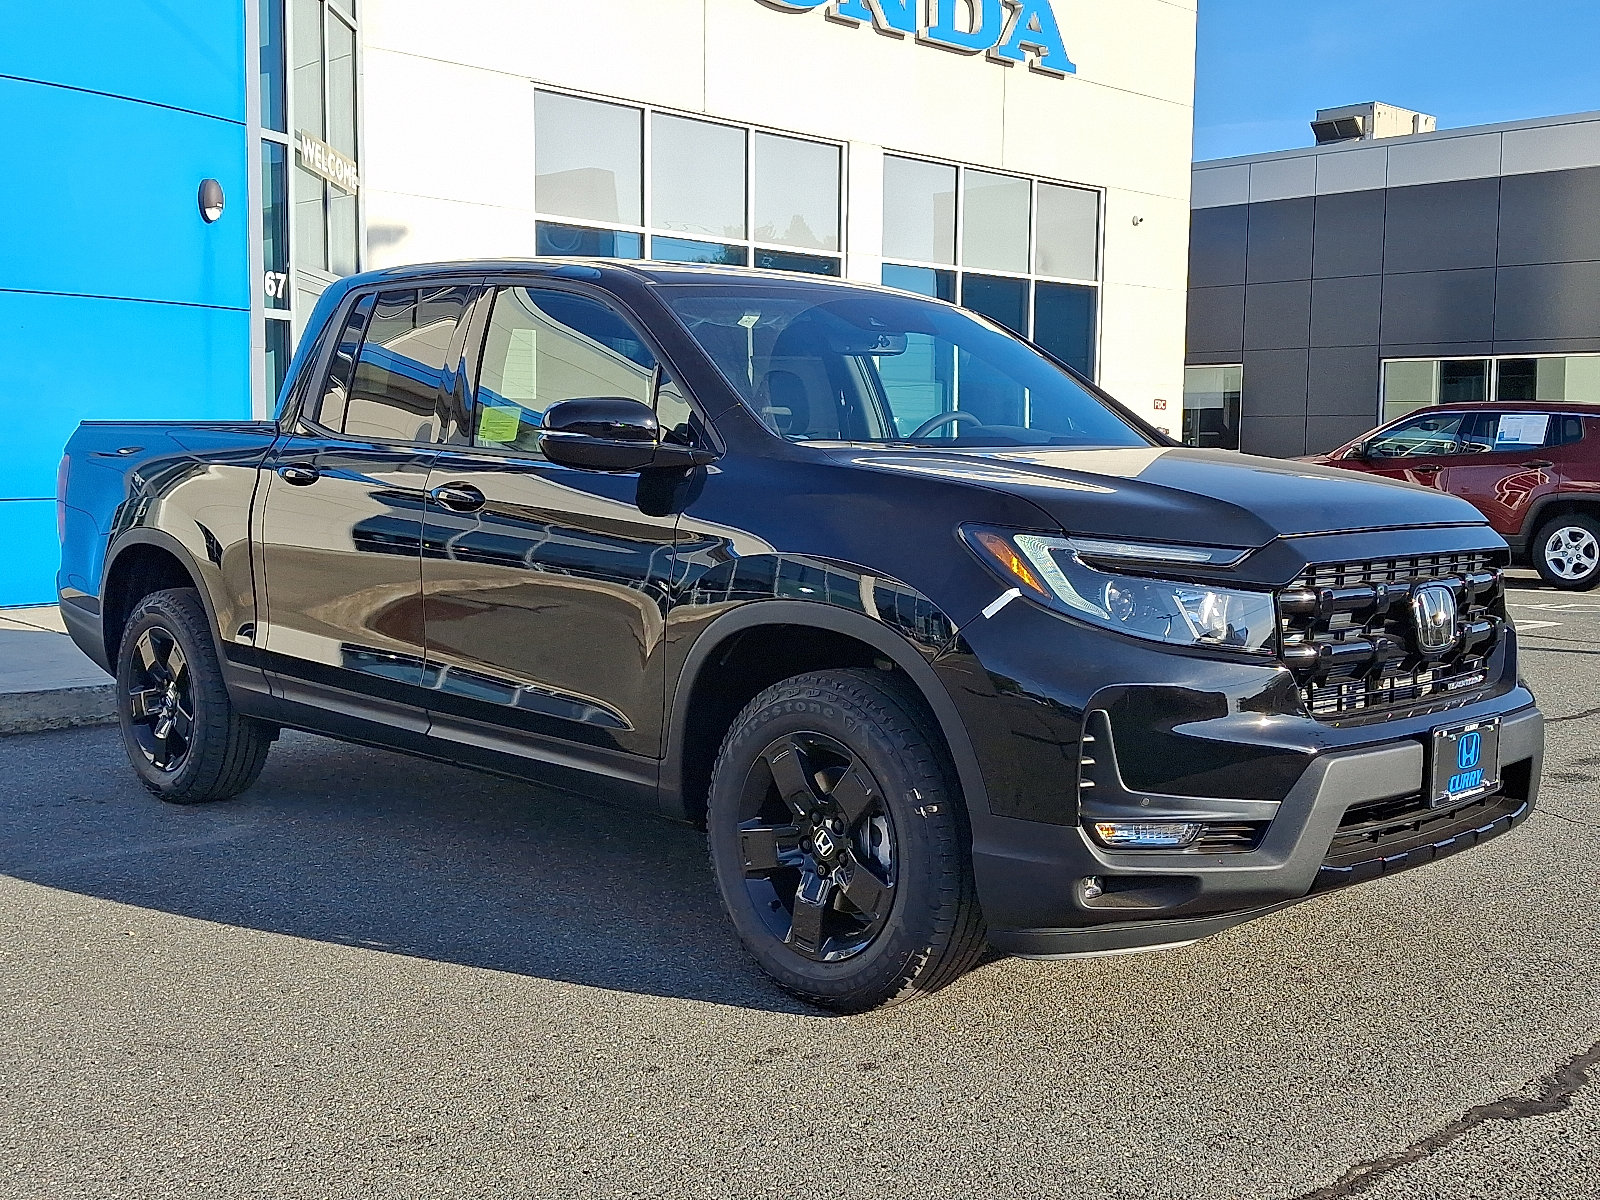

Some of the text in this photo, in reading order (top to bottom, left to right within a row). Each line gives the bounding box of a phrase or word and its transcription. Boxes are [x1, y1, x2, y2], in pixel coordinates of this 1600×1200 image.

[302, 135, 357, 191] WELCOME
[265, 271, 287, 298] 67
[1449, 768, 1484, 793] CURRY
